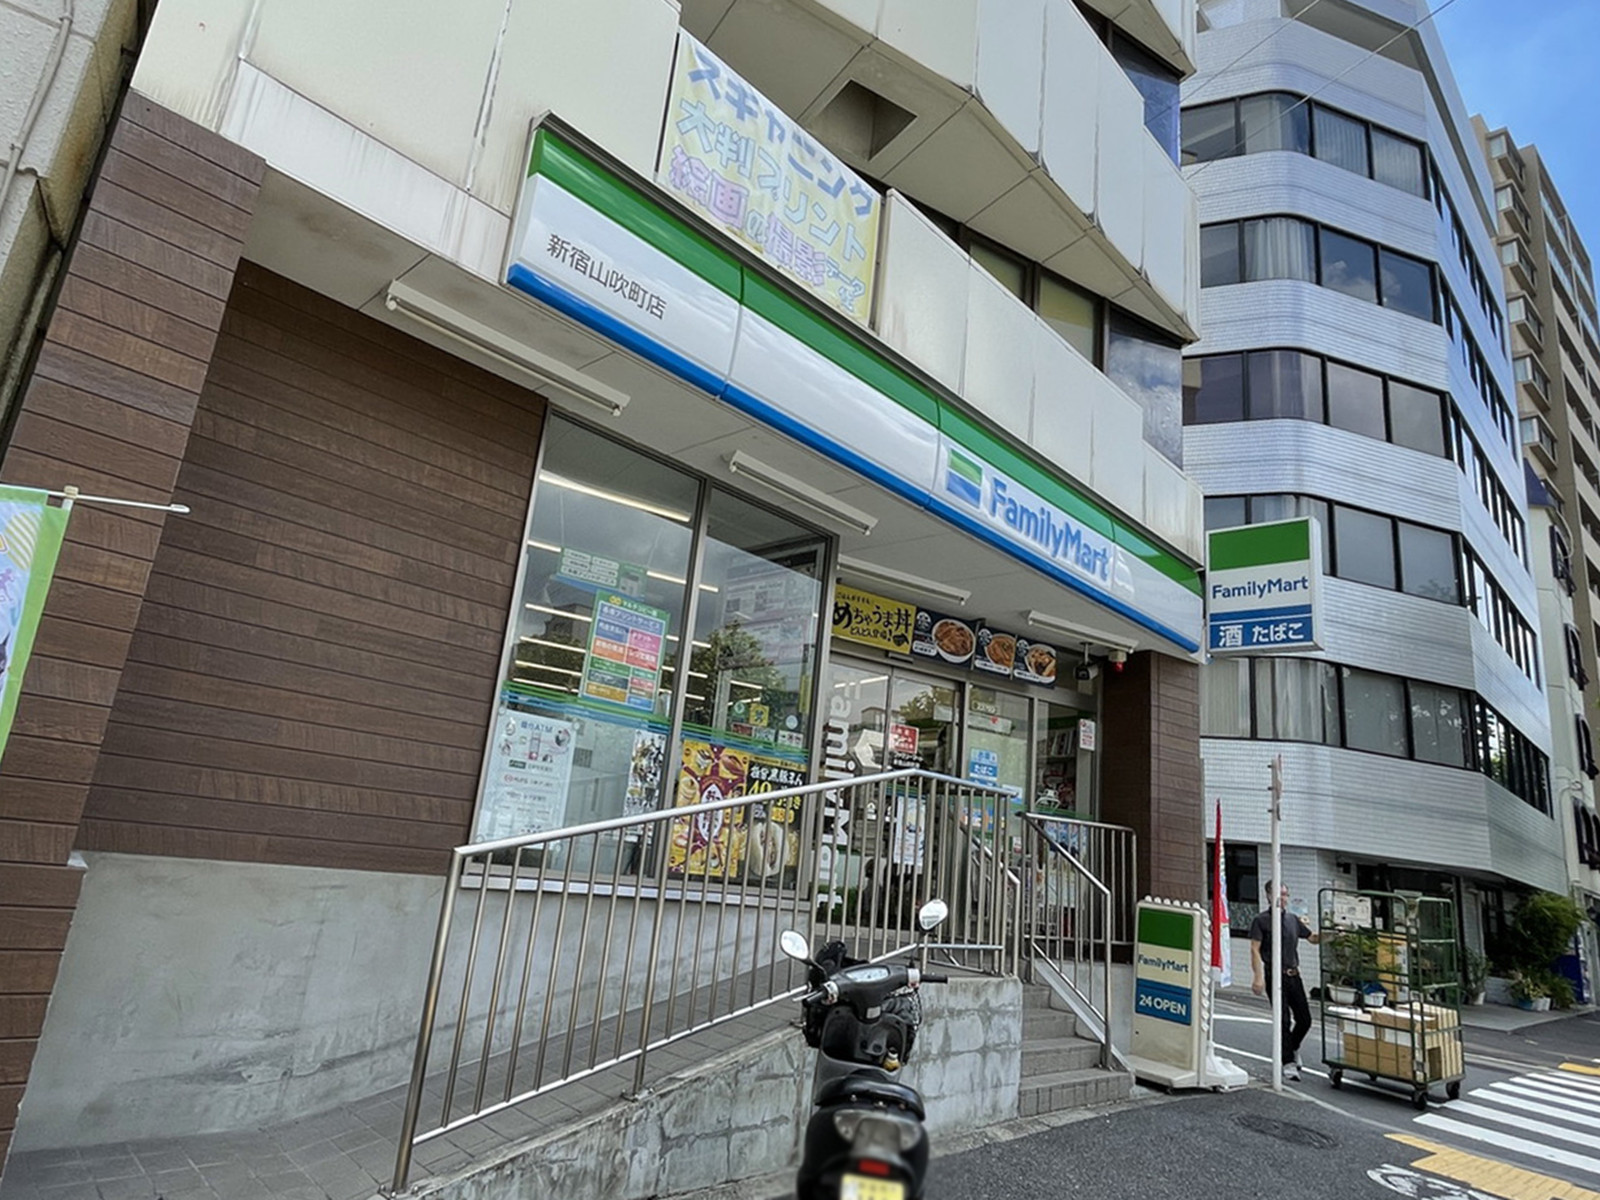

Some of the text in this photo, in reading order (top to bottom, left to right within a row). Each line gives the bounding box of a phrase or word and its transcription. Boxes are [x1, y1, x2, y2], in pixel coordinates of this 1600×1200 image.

[546, 233, 667, 320] 新宿山吹町店
[991, 477, 1109, 581] FamilyMart
[1211, 575, 1310, 600] FamilyMart
[831, 601, 912, 634] めちゃうま丼
[1218, 621, 1305, 647] 酒 たばこ
[1138, 955, 1188, 973] FamilyMart
[1139, 994, 1186, 1016] 24 OPEN
